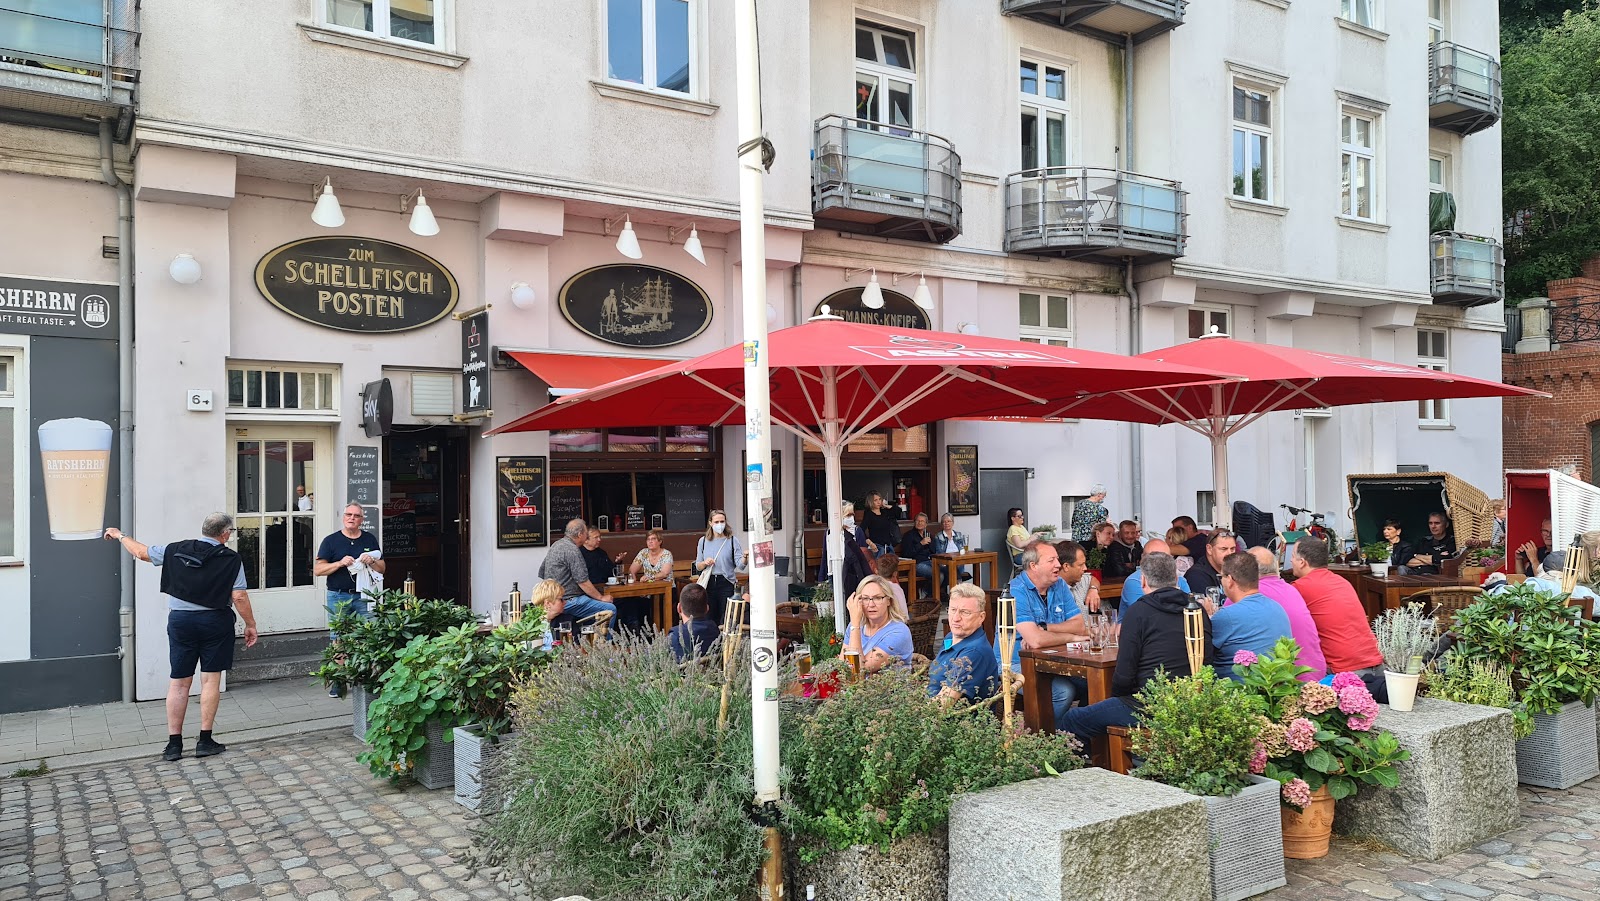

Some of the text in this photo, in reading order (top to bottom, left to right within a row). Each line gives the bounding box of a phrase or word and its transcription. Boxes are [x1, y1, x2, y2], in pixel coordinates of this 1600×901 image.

[348, 249, 375, 263] ZUM
[284, 259, 434, 295] SCHELLFISCH
[317, 290, 405, 319] POSTEN
[16, 315, 37, 325] REAL
[39, 317, 66, 327] TASTE.
[364, 393, 378, 423] sky
[348, 451, 376, 460] Fassbier
[47, 459, 105, 470] RATSHERRN
[509, 507, 534, 515] ASTRA
